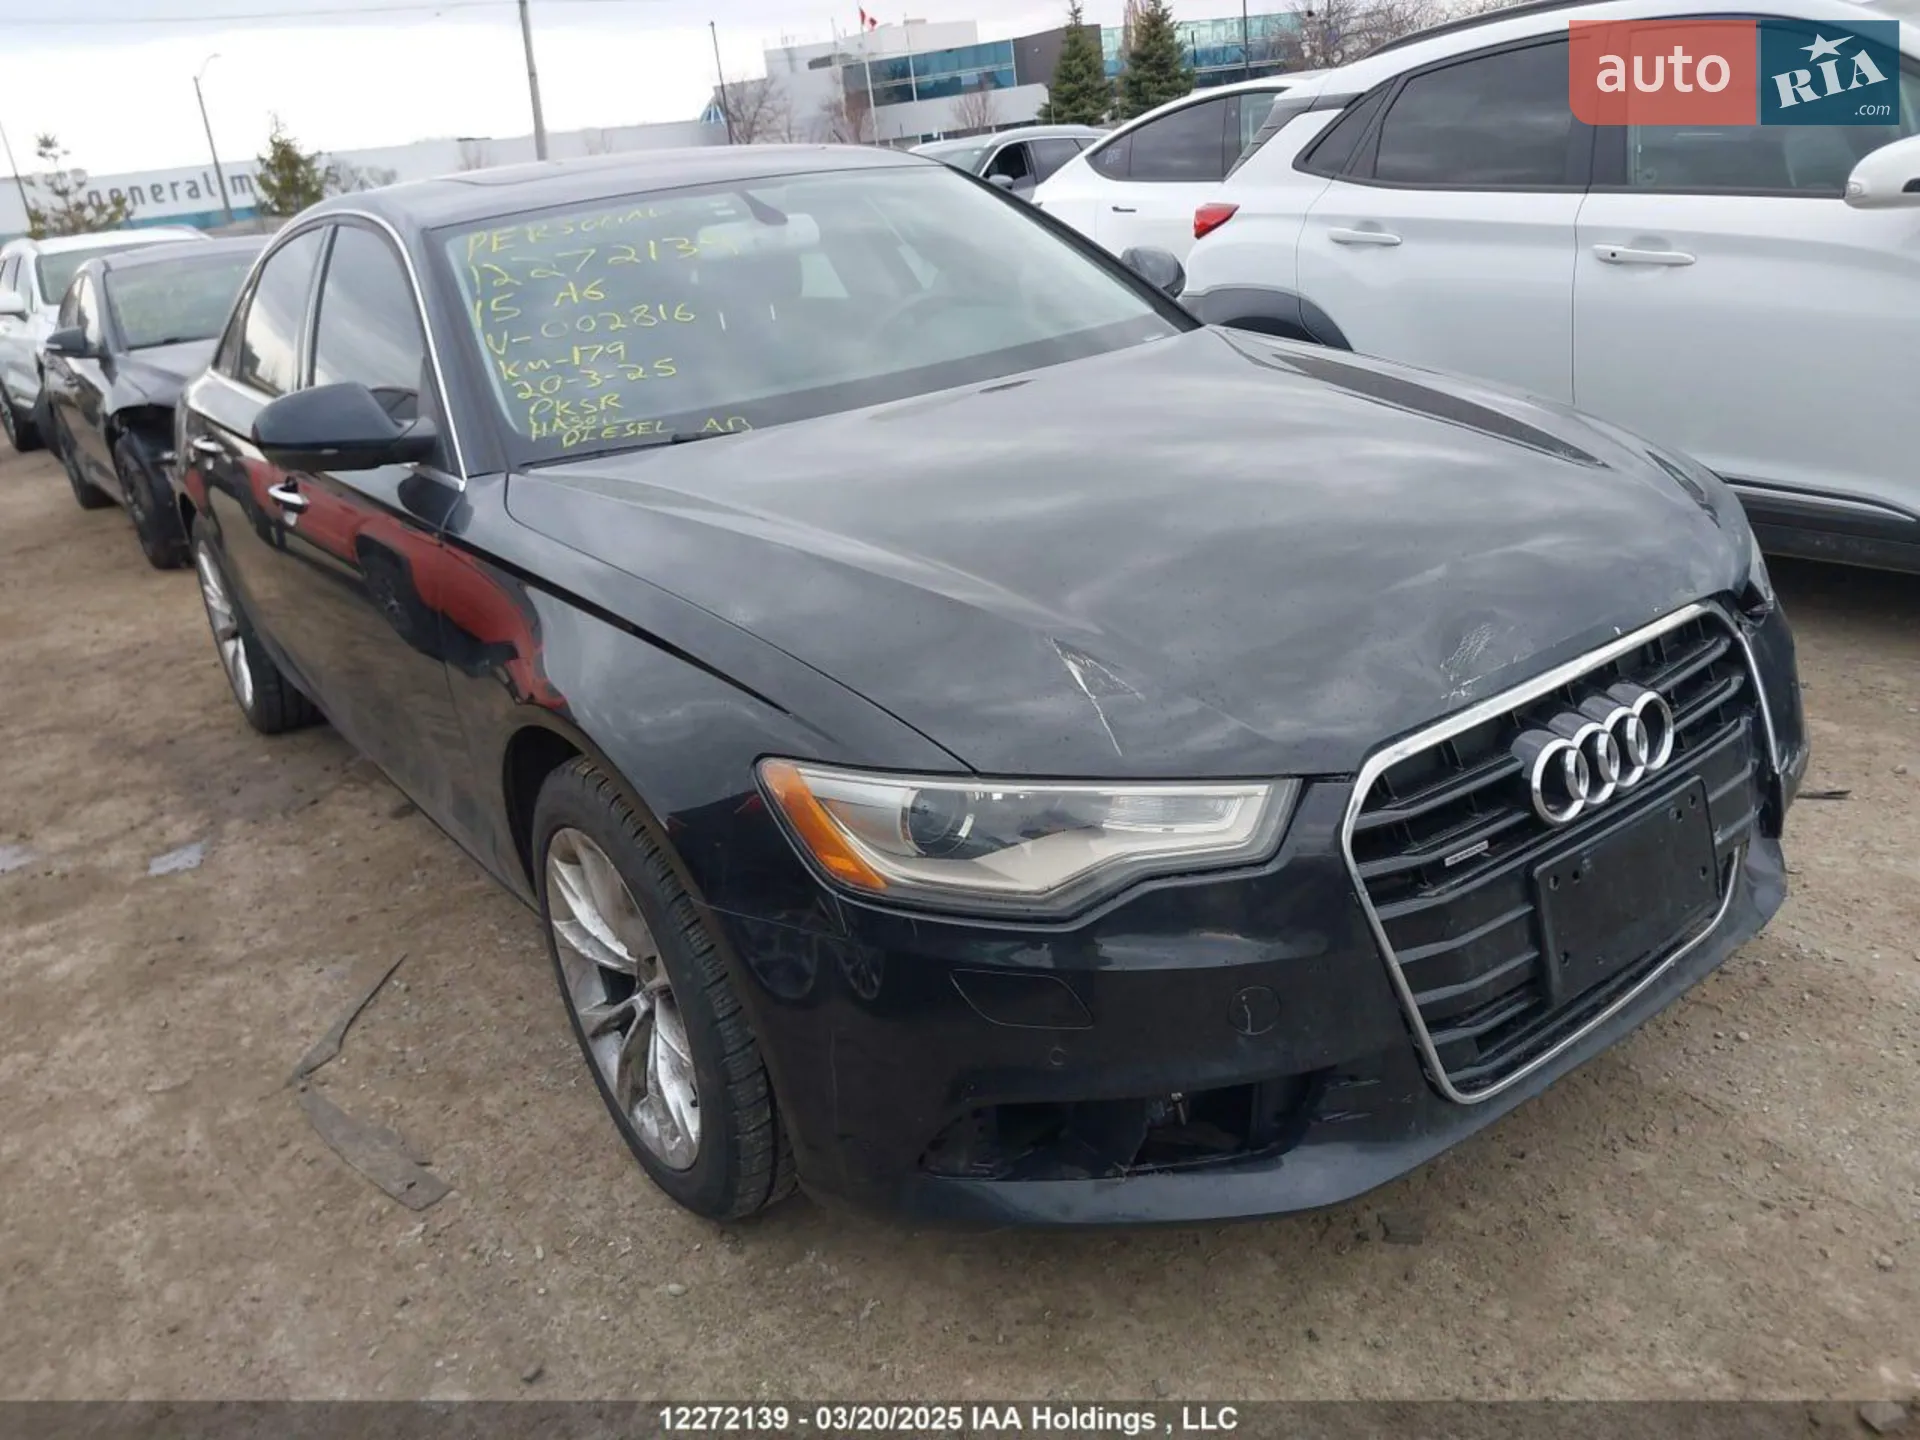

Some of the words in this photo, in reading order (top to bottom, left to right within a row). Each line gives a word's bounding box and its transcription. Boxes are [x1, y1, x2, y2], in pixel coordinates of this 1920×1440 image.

[473, 291, 521, 328] 15
[553, 278, 606, 306] A6
[562, 420, 676, 448] DIESEL
